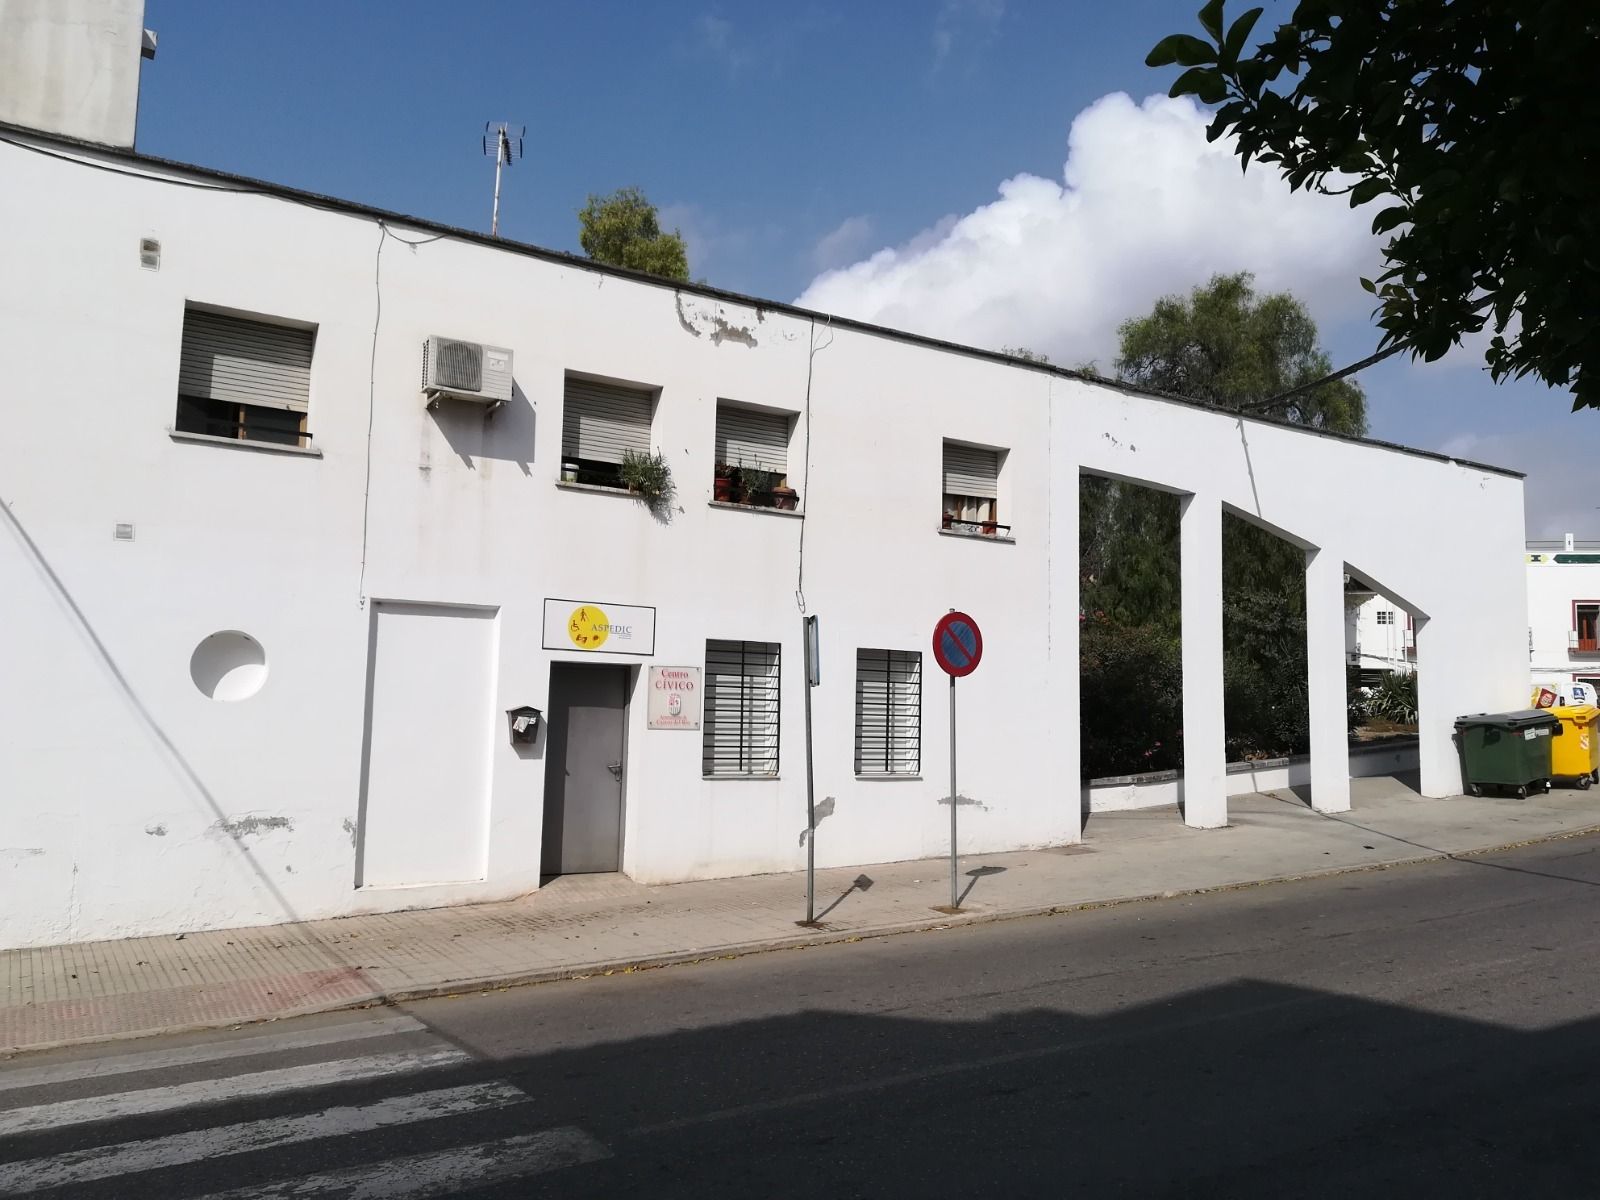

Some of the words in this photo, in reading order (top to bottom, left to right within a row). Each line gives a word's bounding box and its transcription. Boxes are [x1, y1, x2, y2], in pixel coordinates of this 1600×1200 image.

[591, 623, 632, 634] ASPEDIC
[661, 668, 689, 679] Centro
[655, 678, 694, 690] CÍVICO
